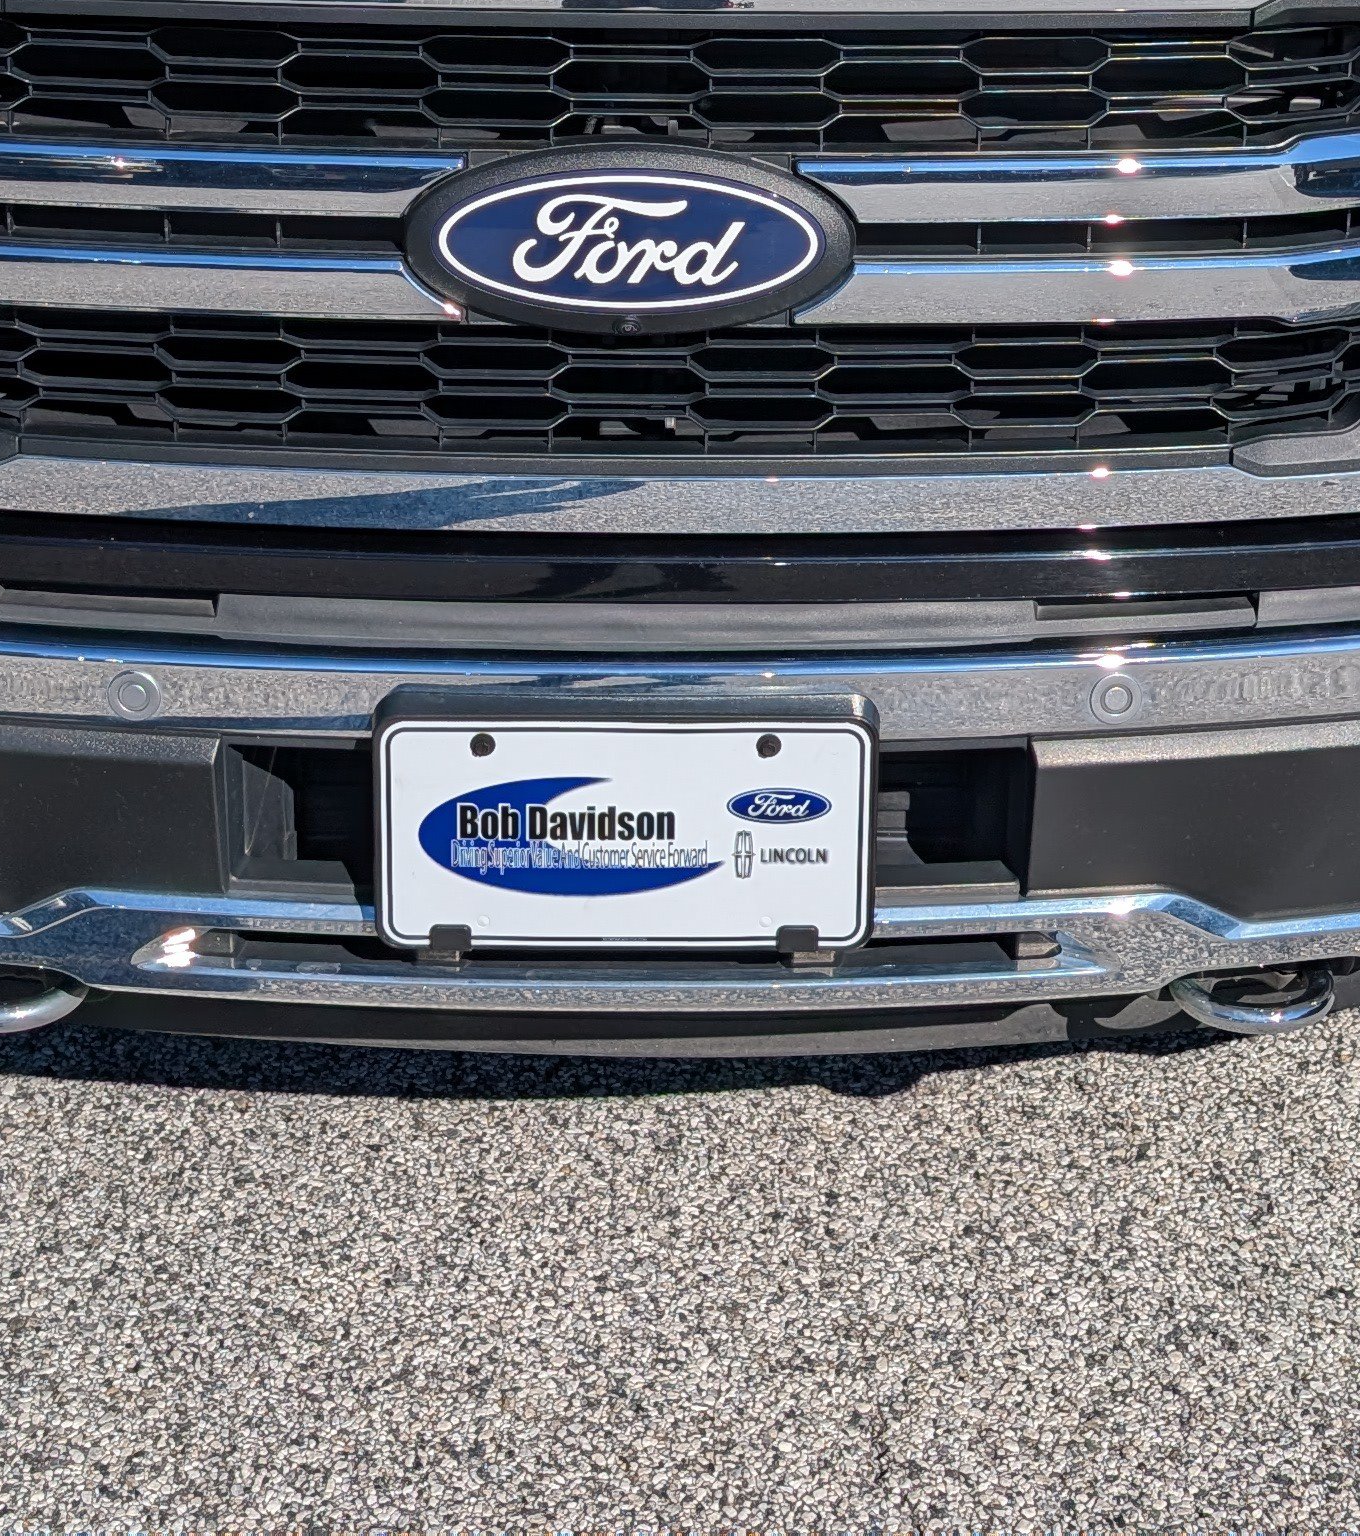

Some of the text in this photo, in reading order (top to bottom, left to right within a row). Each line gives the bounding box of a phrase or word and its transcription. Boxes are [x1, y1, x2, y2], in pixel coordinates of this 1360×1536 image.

[512, 193, 746, 286] Ford
[457, 802, 676, 841] Bob Davidson
[747, 793, 811, 817] Ford
[451, 839, 708, 875] Driving Superior Value And Customer Service Forward
[760, 847, 828, 864] LINCOLN
